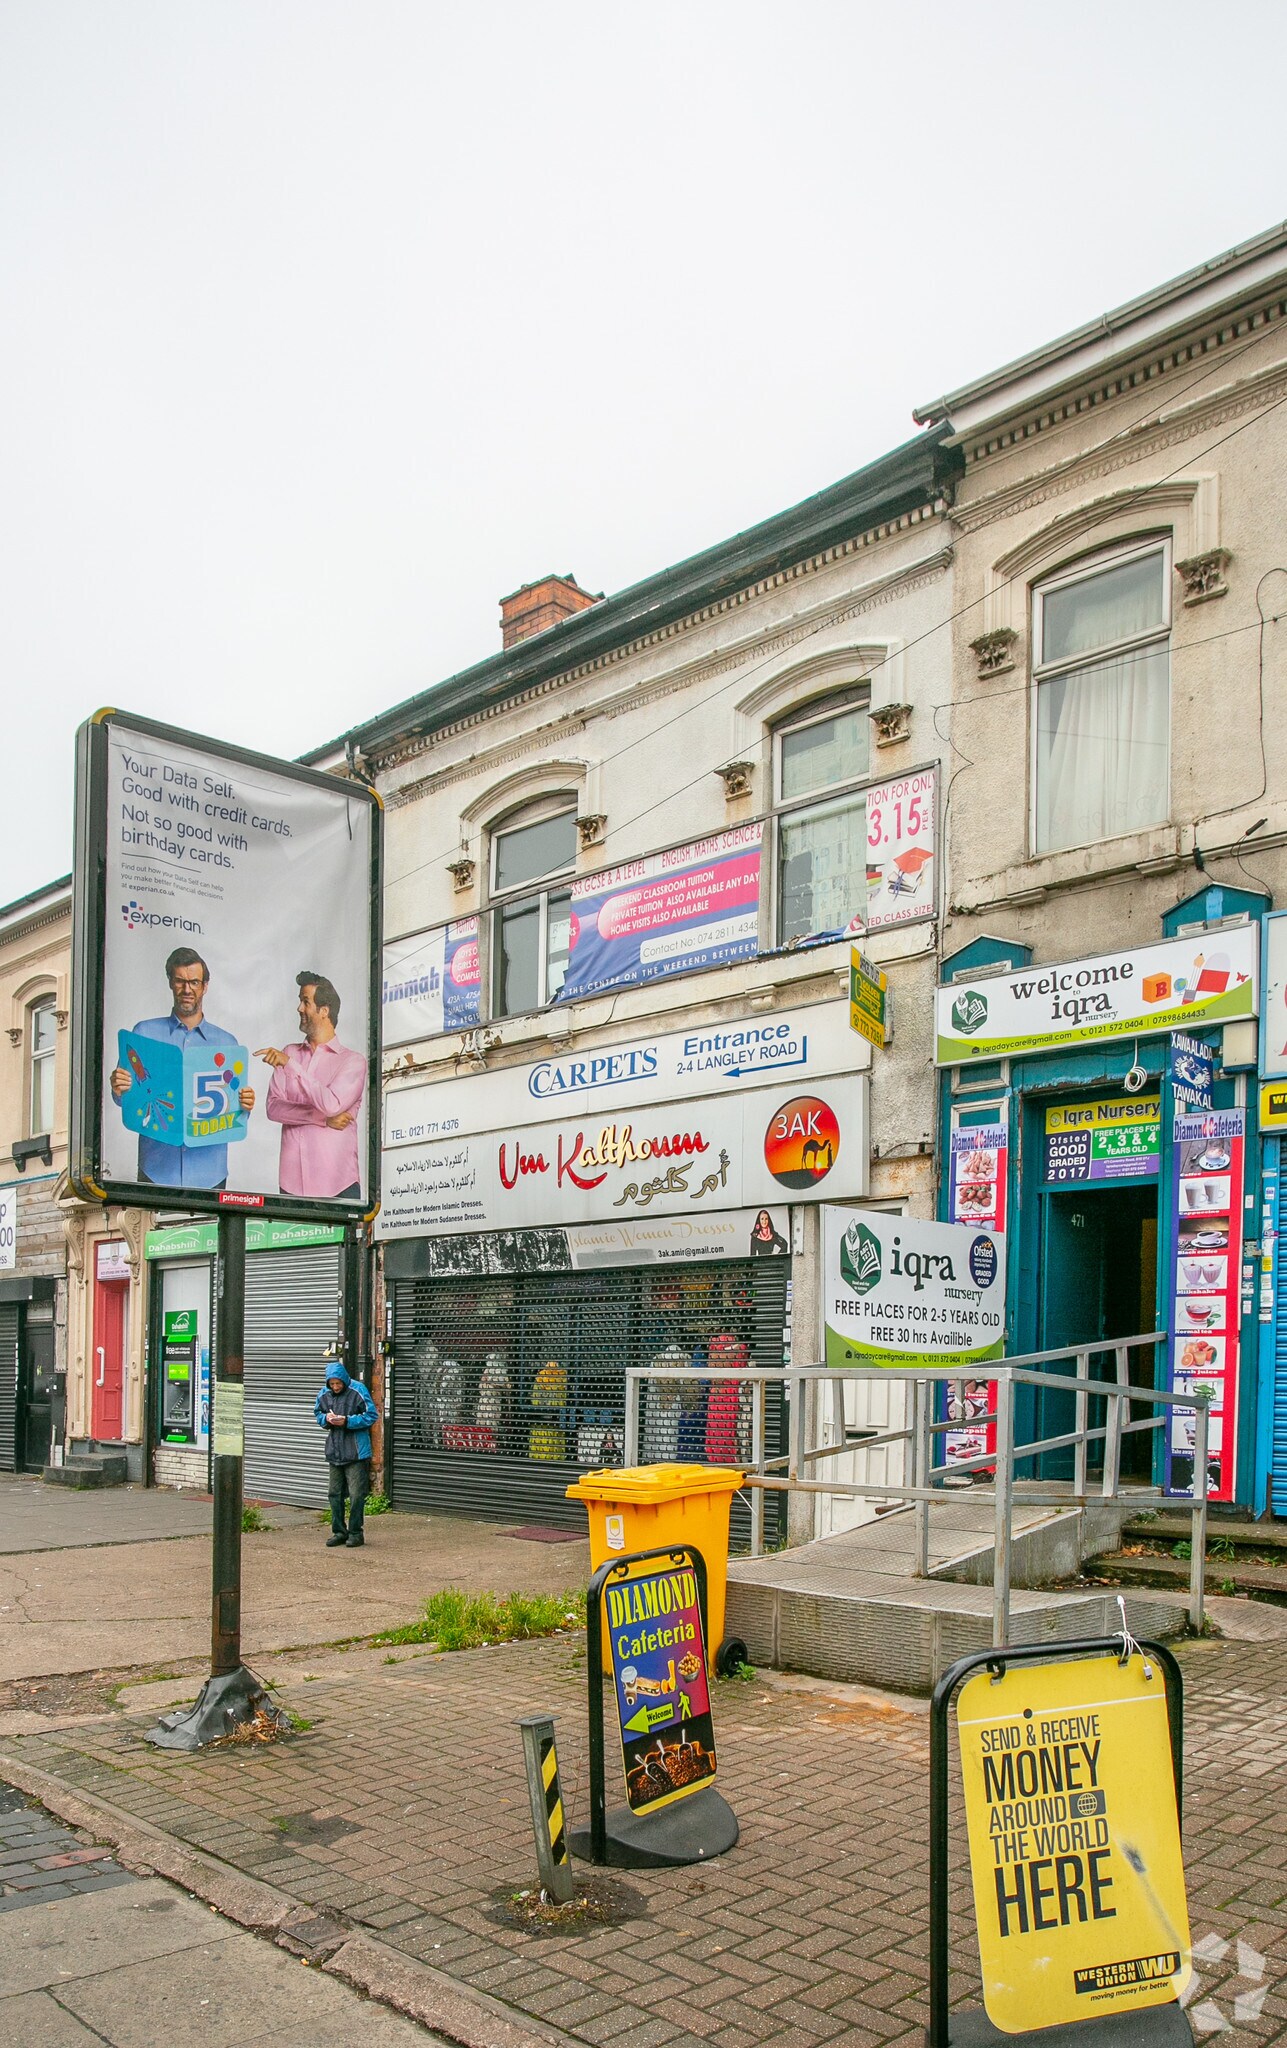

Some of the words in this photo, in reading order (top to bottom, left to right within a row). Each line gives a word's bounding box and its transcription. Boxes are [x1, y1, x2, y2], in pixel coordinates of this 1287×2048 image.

[122, 754, 157, 778] Your
[163, 766, 197, 789] Data
[203, 777, 235, 799] Self.
[891, 782, 909, 799] FOR
[912, 774, 935, 793] ONLY
[122, 777, 162, 802] Good
[168, 792, 199, 812] with
[205, 803, 247, 825] credit
[251, 815, 293, 837] cards.
[868, 796, 921, 846] 3.15
[122, 804, 149, 824] Not
[154, 816, 171, 831] so
[178, 822, 212, 842] good
[218, 833, 247, 851] with
[122, 826, 185, 859] birthday
[190, 847, 234, 869] cards.
[662, 848, 692, 868] ENGLISH,
[694, 837, 720, 858] MATHS,
[723, 826, 754, 849] SCIENCE
[757, 824, 761, 838] &
[585, 873, 605, 892] GCSE
[608, 872, 612, 885] &
[616, 868, 621, 881] A
[624, 860, 645, 880] LEVEL
[643, 880, 686, 900] CLASSROOM
[688, 871, 714, 887] TUITION
[129, 885, 175, 896] experian.co.uk
[612, 907, 636, 922] PRIVATE
[639, 900, 662, 914] TUITION
[667, 894, 684, 907] ALSO
[686, 882, 724, 900] AVAILABLE
[726, 878, 741, 889] ANY
[744, 872, 760, 884] DAY
[611, 924, 630, 935] HOME
[632, 919, 650, 929] VISITS
[652, 911, 669, 924] ALSO
[672, 900, 709, 919] AVAILABLE
[884, 911, 911, 922] CLASS
[643, 941, 678, 958] Contact
[681, 937, 695, 948] No:
[698, 934, 713, 944] 074
[715, 927, 735, 939] 2811
[624, 972, 636, 980] ON
[642, 966, 658, 976] THE
[663, 955, 706, 971] WEEKEND
[712, 942, 757, 959] BETWEEN
[1010, 962, 1134, 999] welcome
[1155, 981, 1167, 998] B
[409, 991, 440, 1004] Tuition
[1051, 991, 1112, 1025] iqra
[1085, 1010, 1118, 1022] nursery
[684, 1023, 791, 1056] Entrance
[983, 1032, 1072, 1053] iqradaycare@gmail.com
[1089, 1027, 1107, 1035] 0121
[1110, 1023, 1123, 1032] 572
[1125, 1020, 1143, 1030] 0404
[1153, 1009, 1206, 1025] 07898684433
[677, 1060, 694, 1075] 2-4
[697, 1049, 755, 1071] LANGLEY
[759, 1041, 798, 1060] ROAD
[1171, 1032, 1213, 1062] XAWAALADA
[529, 1047, 657, 1097] CARPETS
[193, 1071, 228, 1119] 5
[1172, 1083, 1213, 1110] TAWAKAL
[192, 1113, 235, 1136] TODAY
[776, 1110, 822, 1139] 3AK
[1064, 1110, 1094, 1127] Iqra
[1098, 1102, 1160, 1120] Nursery
[1175, 1118, 1208, 1141] Diamond
[1209, 1114, 1242, 1137] Cafeteria
[391, 1129, 406, 1140] TEL:
[409, 1125, 424, 1137] 0121
[427, 1122, 438, 1133] 771
[442, 1119, 459, 1131] 4376
[1050, 1134, 1087, 1145] Ofsted
[1095, 1129, 1114, 1137] FREE
[1115, 1125, 1143, 1135] PLACES
[1118, 1135, 1126, 1146] 3
[1132, 1133, 1142, 1145] &
[1148, 1131, 1156, 1143] 4
[500, 1141, 550, 1189] Um
[558, 1124, 710, 1189] Kalthoum
[1049, 1157, 1086, 1168] GRADED
[1050, 1144, 1086, 1157] GOOD
[1107, 1146, 1130, 1155] YEARS
[223, 1194, 260, 1204] primesight
[392, 1206, 414, 1215] Kalthoum
[423, 1202, 440, 1212] Modern
[442, 1202, 460, 1210] Islamic
[461, 1200, 483, 1208] Dresses.
[390, 1219, 412, 1228] Kalthoum
[420, 1216, 438, 1225] Modern
[440, 1215, 464, 1223] Sudanese
[1072, 1214, 1084, 1227] 471
[569, 1232, 616, 1251] Islamic
[618, 1226, 672, 1248] Women
[672, 1222, 735, 1238] Dresses
[658, 1245, 724, 1258] 3ak.amir@gmail.com
[890, 1237, 956, 1291] iqra
[974, 1246, 993, 1258] Ofsted
[944, 1287, 983, 1307] nursery
[836, 1300, 860, 1316] FREE
[865, 1302, 904, 1320] PLACES
[908, 1306, 927, 1321] FOR
[931, 1309, 947, 1323] 2-5
[950, 1309, 979, 1325] YEARS
[982, 1313, 999, 1326] OLD
[871, 1327, 894, 1342] FREE
[897, 1329, 910, 1342] 30
[913, 1329, 927, 1343] hrs
[931, 1331, 972, 1347] Availible
[609, 1573, 696, 1628] DIAMOND
[618, 1619, 695, 1660] Cafeteria
[647, 1706, 671, 1722] Welcome
[981, 1725, 1021, 1753] SEND
[1026, 1724, 1037, 1746] &
[1041, 1715, 1100, 1744] RECEIVE
[983, 1740, 1100, 1804] MONEY
[990, 1795, 1066, 1834] AROUND
[990, 1830, 1030, 1865] THE
[1034, 1818, 1109, 1857] WORLD
[994, 1849, 1117, 1938] HERE
[1077, 1962, 1136, 1981] WESTERN
[1096, 1972, 1136, 1988] UNION
[1141, 1955, 1176, 1978] WU
[1091, 1992, 1115, 2001] moving
[1116, 1987, 1137, 1996] money
[1150, 1981, 1169, 1990] better
